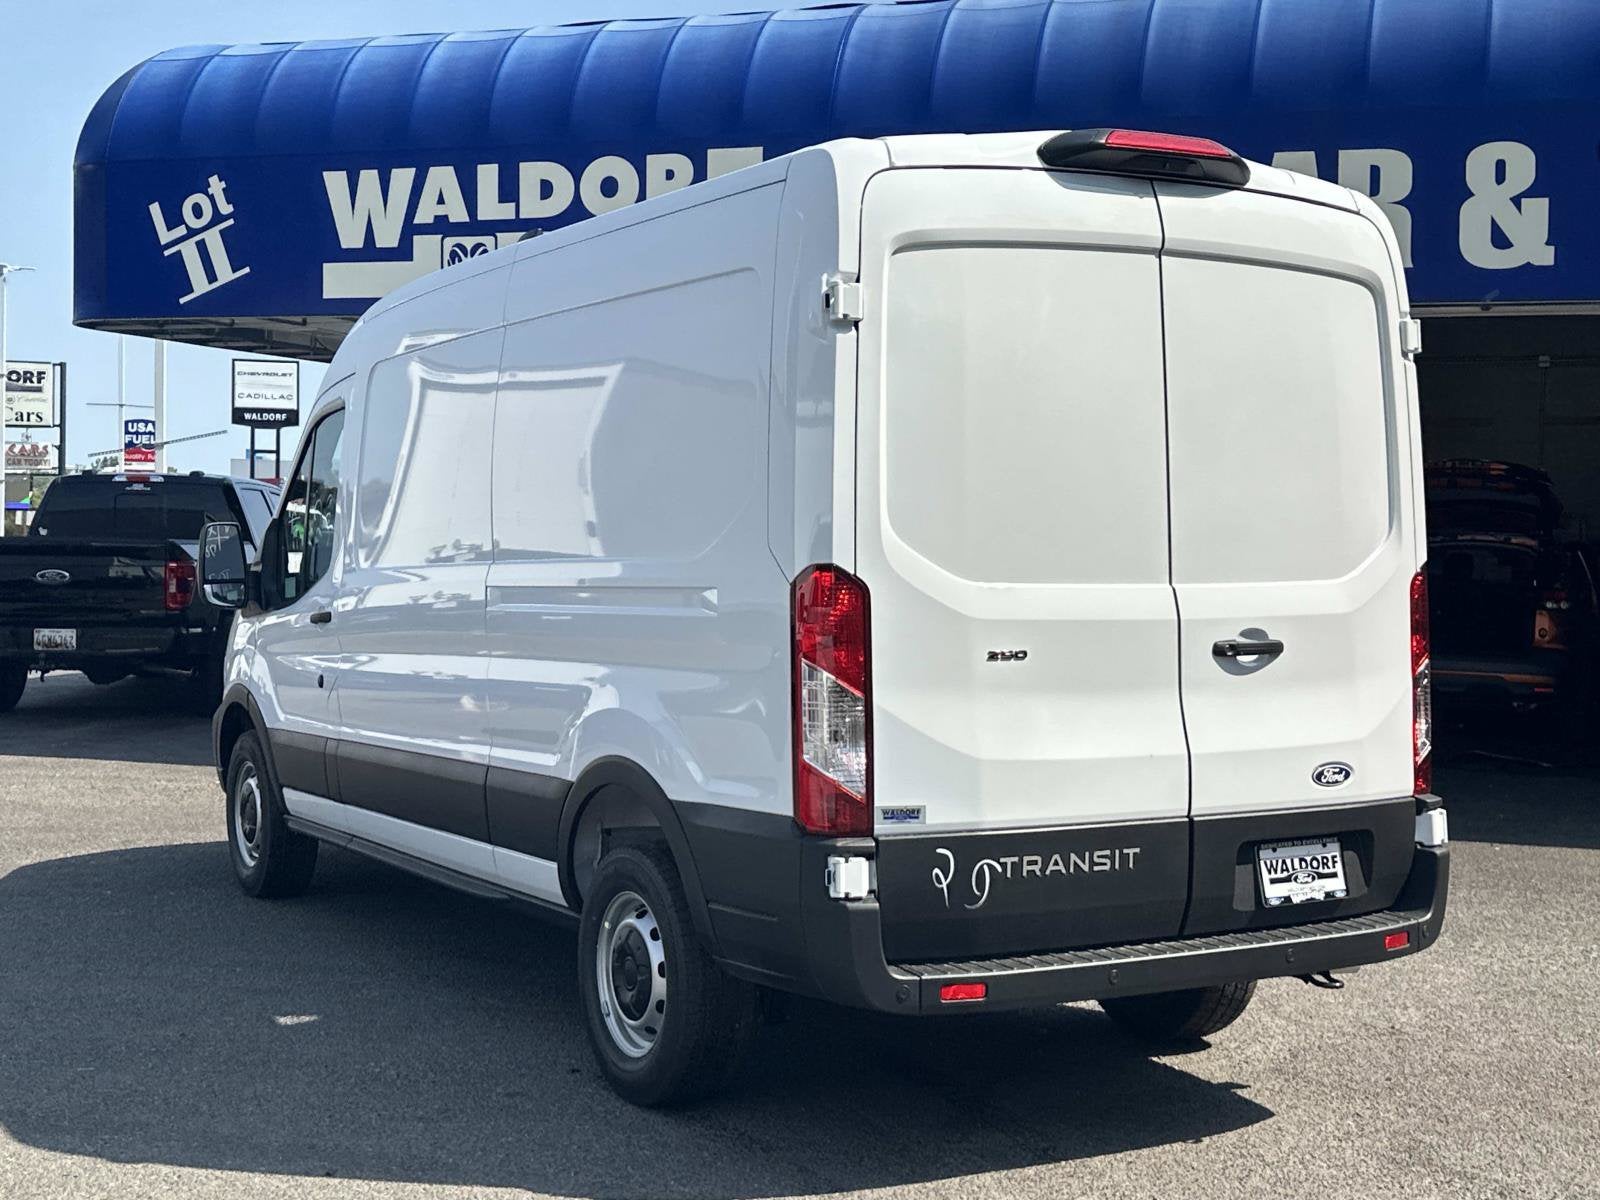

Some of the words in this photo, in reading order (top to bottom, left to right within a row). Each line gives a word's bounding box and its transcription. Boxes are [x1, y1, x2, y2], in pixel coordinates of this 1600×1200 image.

[149, 174, 234, 246] Lot
[1459, 141, 1555, 269] &
[163, 218, 250, 304] II
[237, 392, 294, 401] CADILLAC
[244, 412, 287, 421] WALDORF
[128, 422, 154, 433] USA
[125, 434, 155, 444] FUEL
[986, 650, 1028, 662] 250
[1320, 767, 1346, 783] Ford
[880, 808, 921, 816] WALDORF
[1000, 847, 1140, 879] TRANSIT
[1264, 854, 1338, 875] WALDORF
